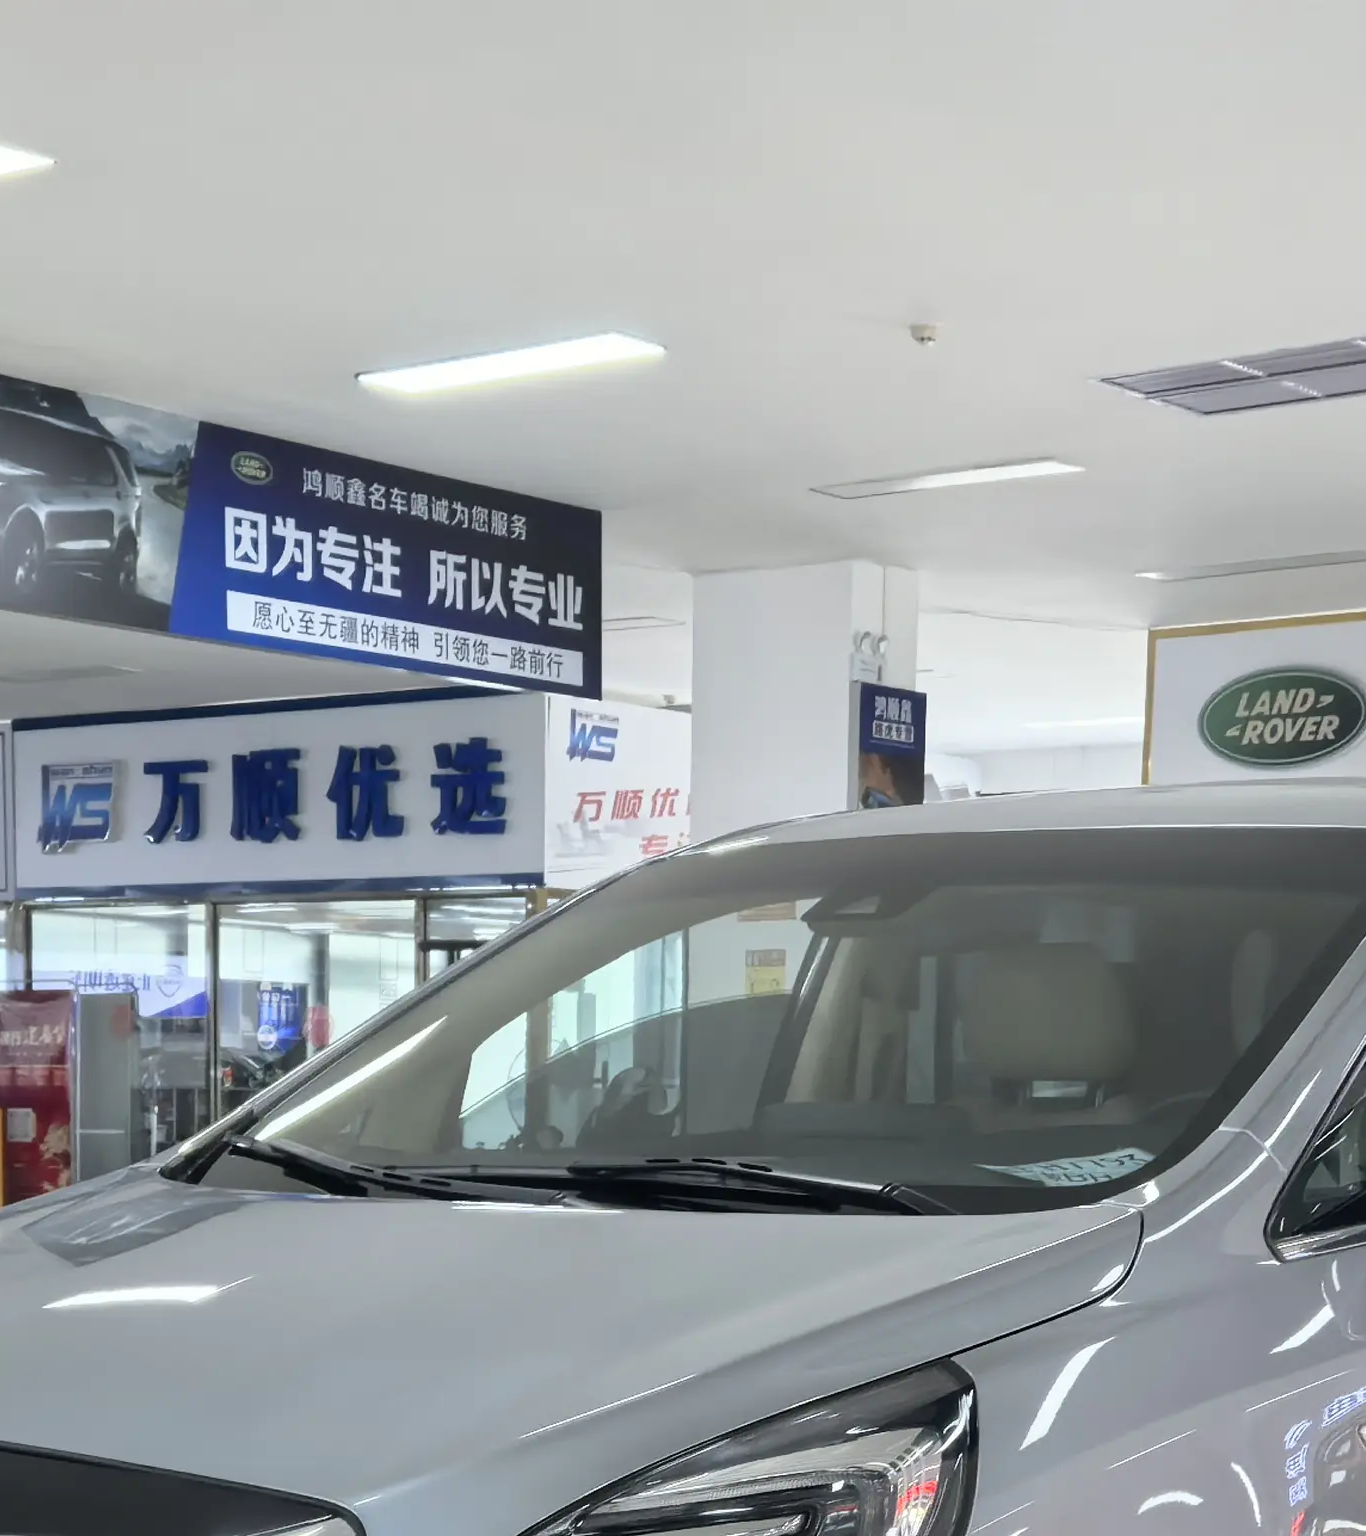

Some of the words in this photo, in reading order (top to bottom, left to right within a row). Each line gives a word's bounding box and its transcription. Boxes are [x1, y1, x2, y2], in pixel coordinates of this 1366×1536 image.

[302, 467, 527, 541] 鸿顺鑫名车竭诚为您服务
[225, 506, 402, 597] 因为专注
[428, 550, 584, 630] 所以专业
[252, 600, 419, 654] 愿心至无疆的精神
[433, 631, 564, 679] 引领您一路前行
[1235, 687, 1315, 718] LAND
[1241, 714, 1340, 746] ROVER
[143, 736, 507, 844] 万顺优选
[573, 788, 691, 823] 万顺优
